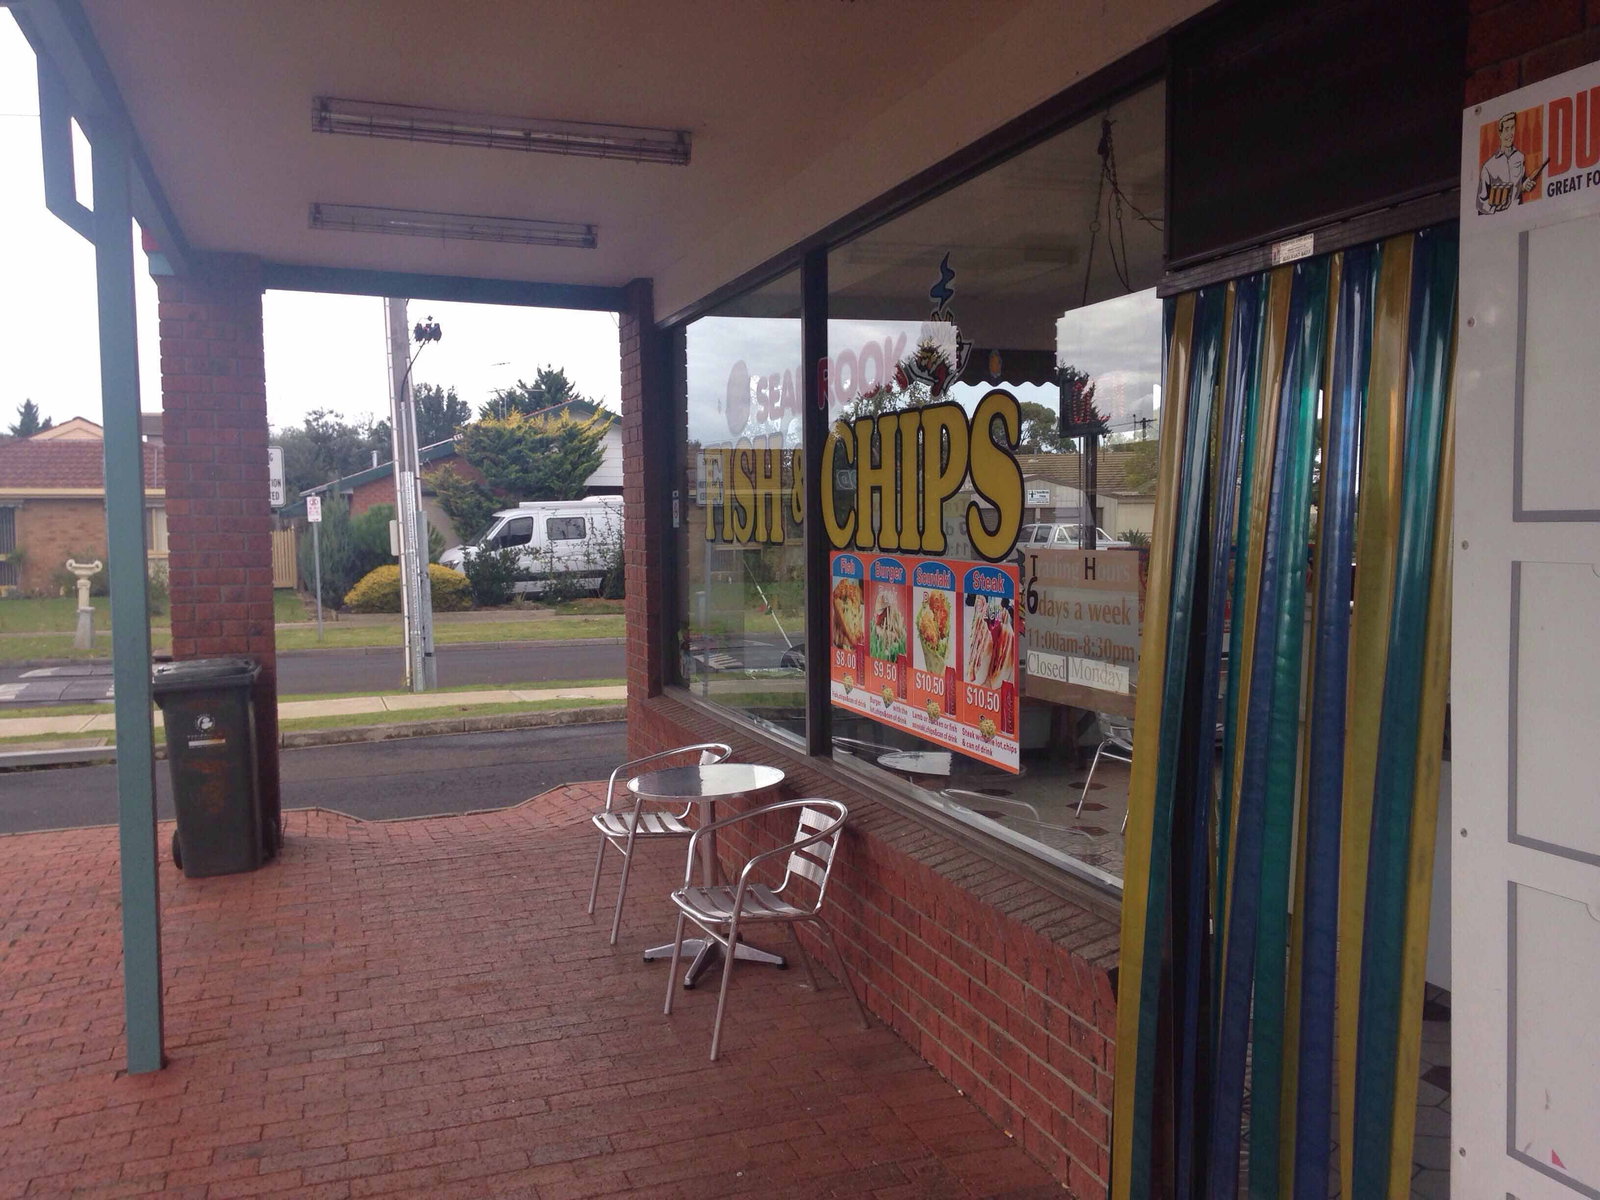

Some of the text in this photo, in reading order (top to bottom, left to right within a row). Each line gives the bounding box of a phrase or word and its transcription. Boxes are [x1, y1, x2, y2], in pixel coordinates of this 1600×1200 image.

[1547, 174, 1582, 198] GREAT
[704, 432, 784, 543] FISH
[820, 388, 1024, 563] CHIPS
[840, 558, 855, 575] Fish
[874, 562, 903, 584] Burger
[972, 570, 1004, 594] Steak
[1074, 601, 1082, 620] a
[1088, 598, 1131, 625] week
[836, 650, 856, 670] $8.00
[874, 660, 896, 682] $9.50
[1028, 652, 1124, 688] Closed Monday
[916, 672, 944, 696] $10.50
[966, 686, 1000, 712] $10.50
